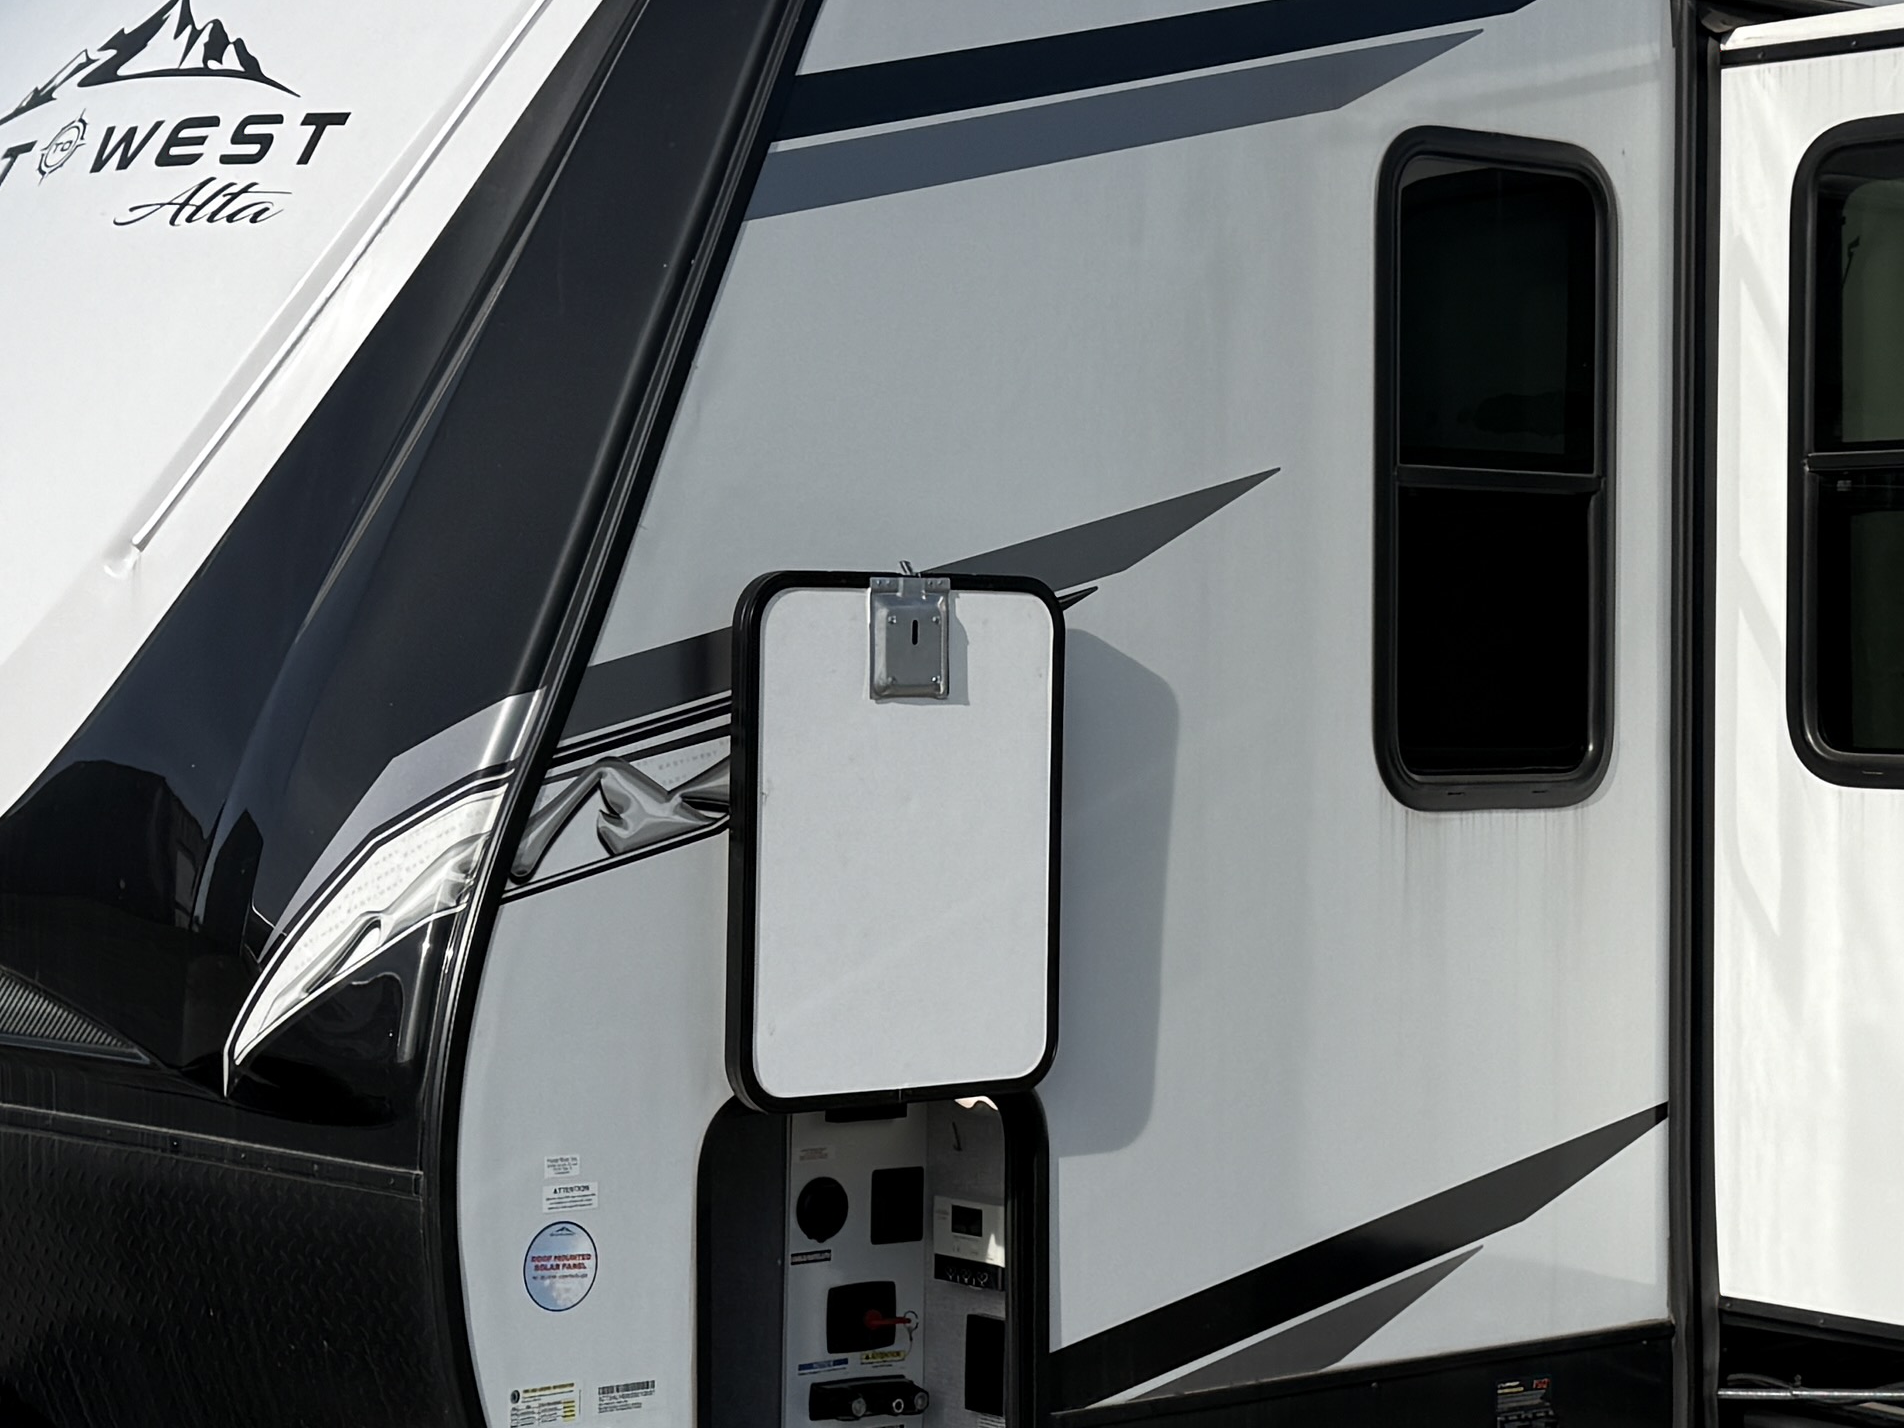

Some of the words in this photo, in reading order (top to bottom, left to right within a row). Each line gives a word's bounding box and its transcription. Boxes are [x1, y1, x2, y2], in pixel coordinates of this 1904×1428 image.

[53, 140, 73, 154] TO
[89, 112, 352, 174] WEST
[113, 177, 292, 227] Alta
